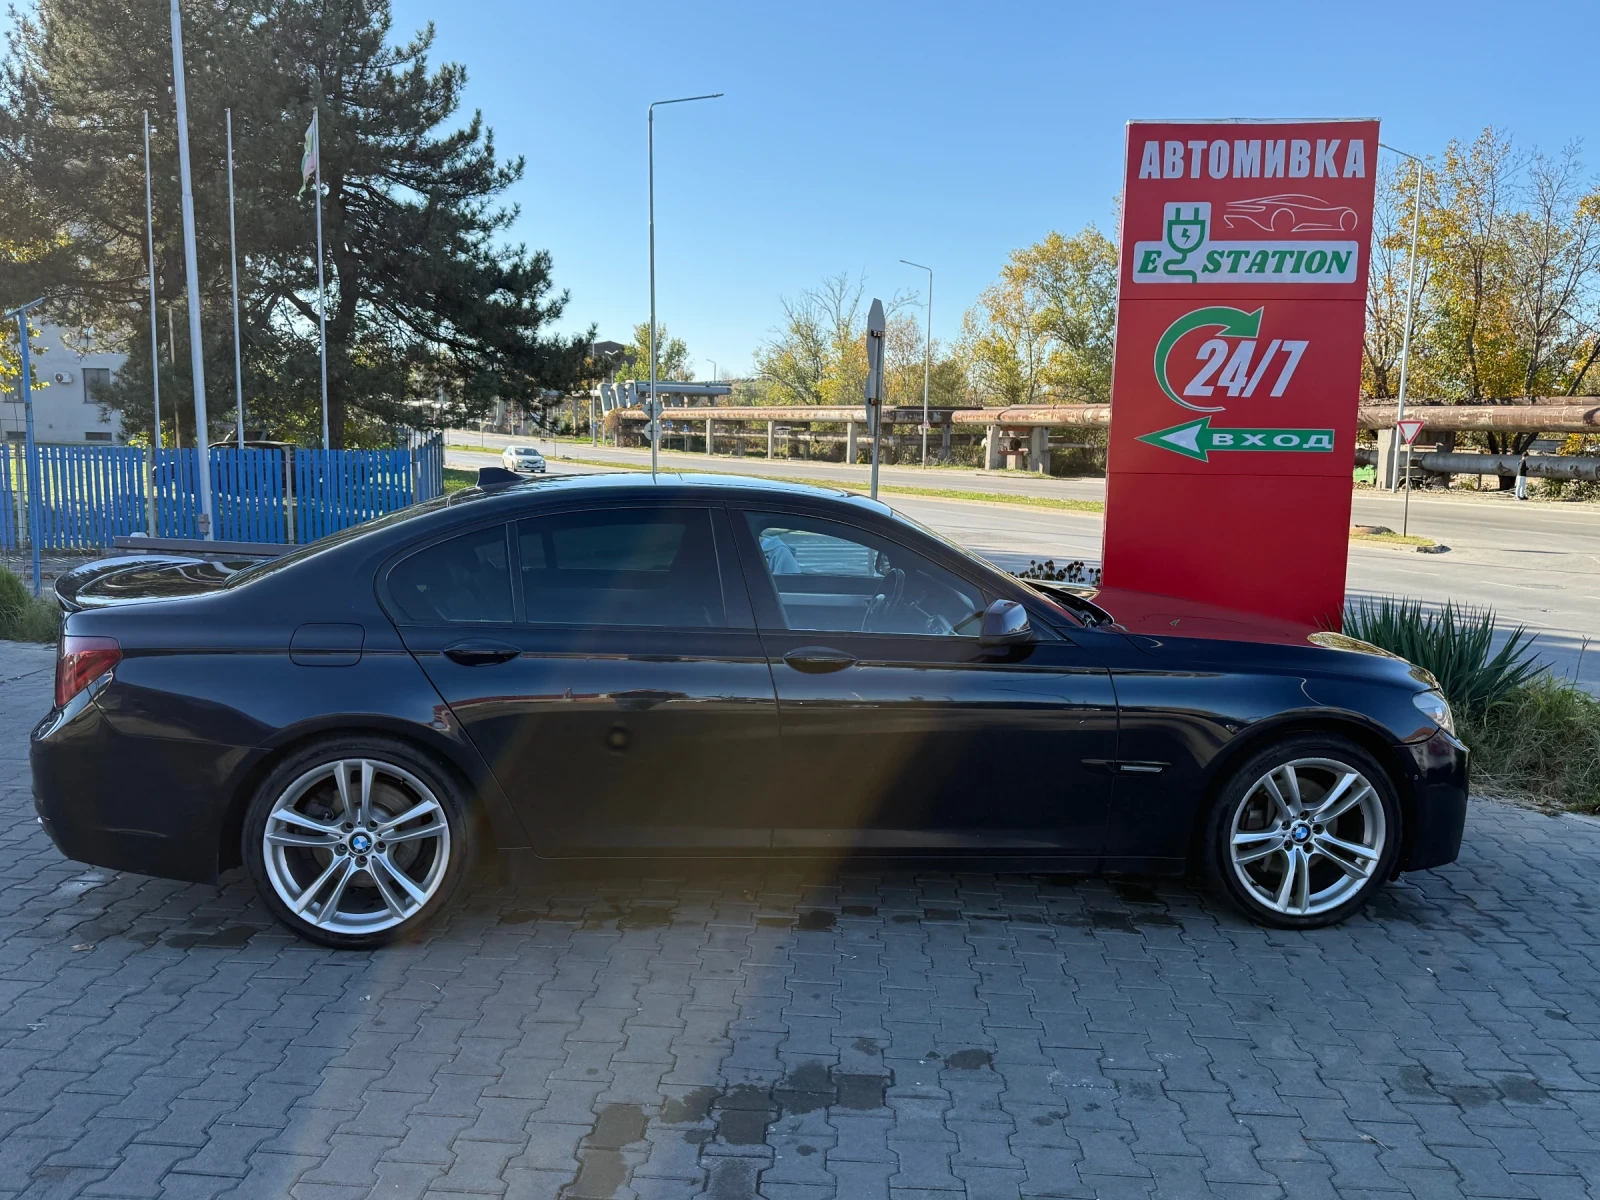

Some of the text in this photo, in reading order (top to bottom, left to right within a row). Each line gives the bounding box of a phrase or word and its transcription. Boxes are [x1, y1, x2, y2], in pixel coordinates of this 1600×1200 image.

[1139, 139, 1365, 179] АВТОМИВКА
[1137, 250, 1353, 274] E STATION
[1183, 339, 1309, 398] 24/7
[1212, 434, 1333, 449] ВХОД
